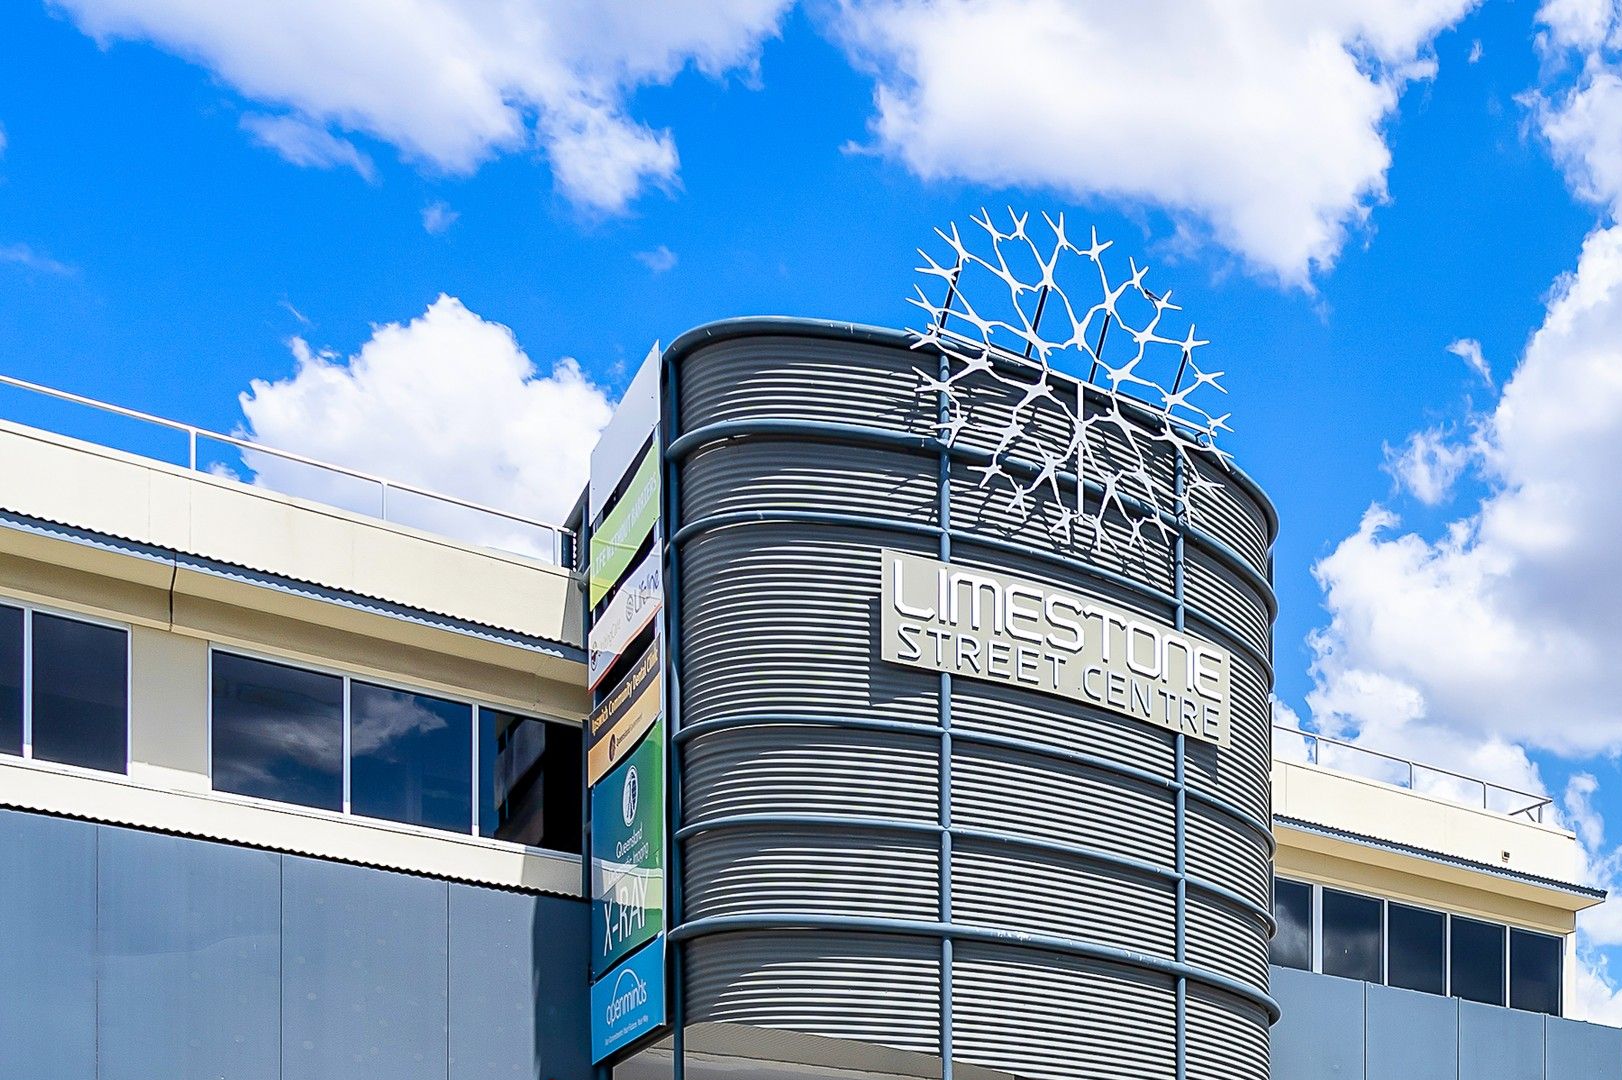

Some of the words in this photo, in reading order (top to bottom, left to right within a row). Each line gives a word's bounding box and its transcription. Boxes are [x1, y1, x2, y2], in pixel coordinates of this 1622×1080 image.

[894, 559, 1223, 700] LIMESTONE
[898, 623, 1067, 689] STREET
[1083, 663, 1220, 741] CENTRE
[604, 867, 650, 957] X-RAY
